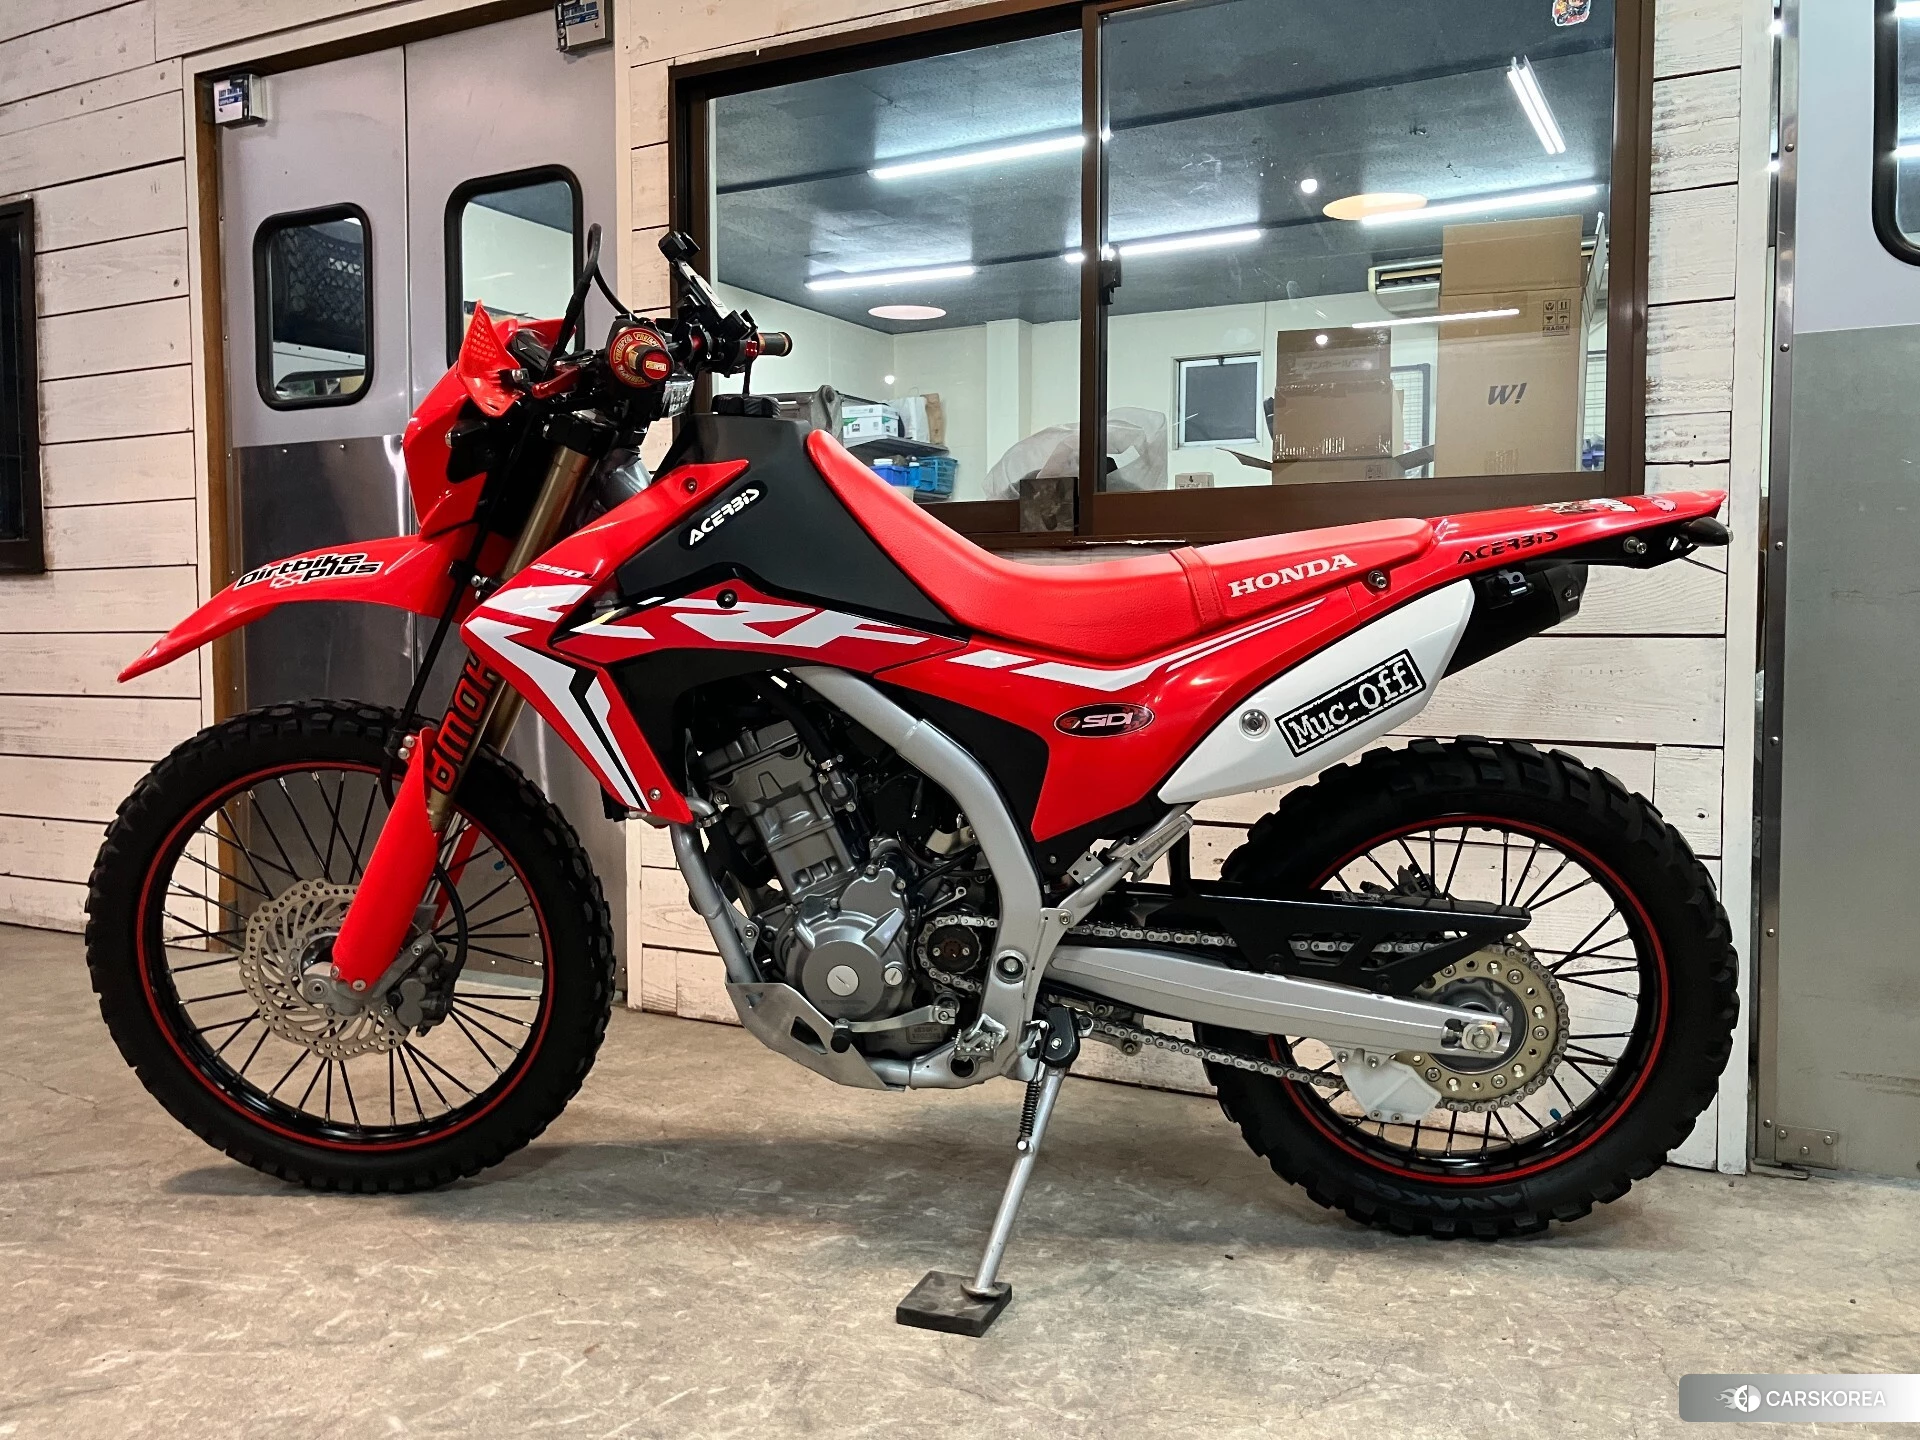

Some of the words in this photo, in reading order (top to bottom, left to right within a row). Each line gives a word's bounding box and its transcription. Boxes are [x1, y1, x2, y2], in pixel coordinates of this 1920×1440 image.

[1487, 382, 1528, 405] W!
[235, 553, 367, 589] Dirtbike
[301, 561, 381, 583] plus
[530, 563, 586, 578] 250
[1228, 553, 1358, 598] HONDA
[1289, 661, 1413, 745] Muc-Off
[428, 656, 494, 793] HOWA
